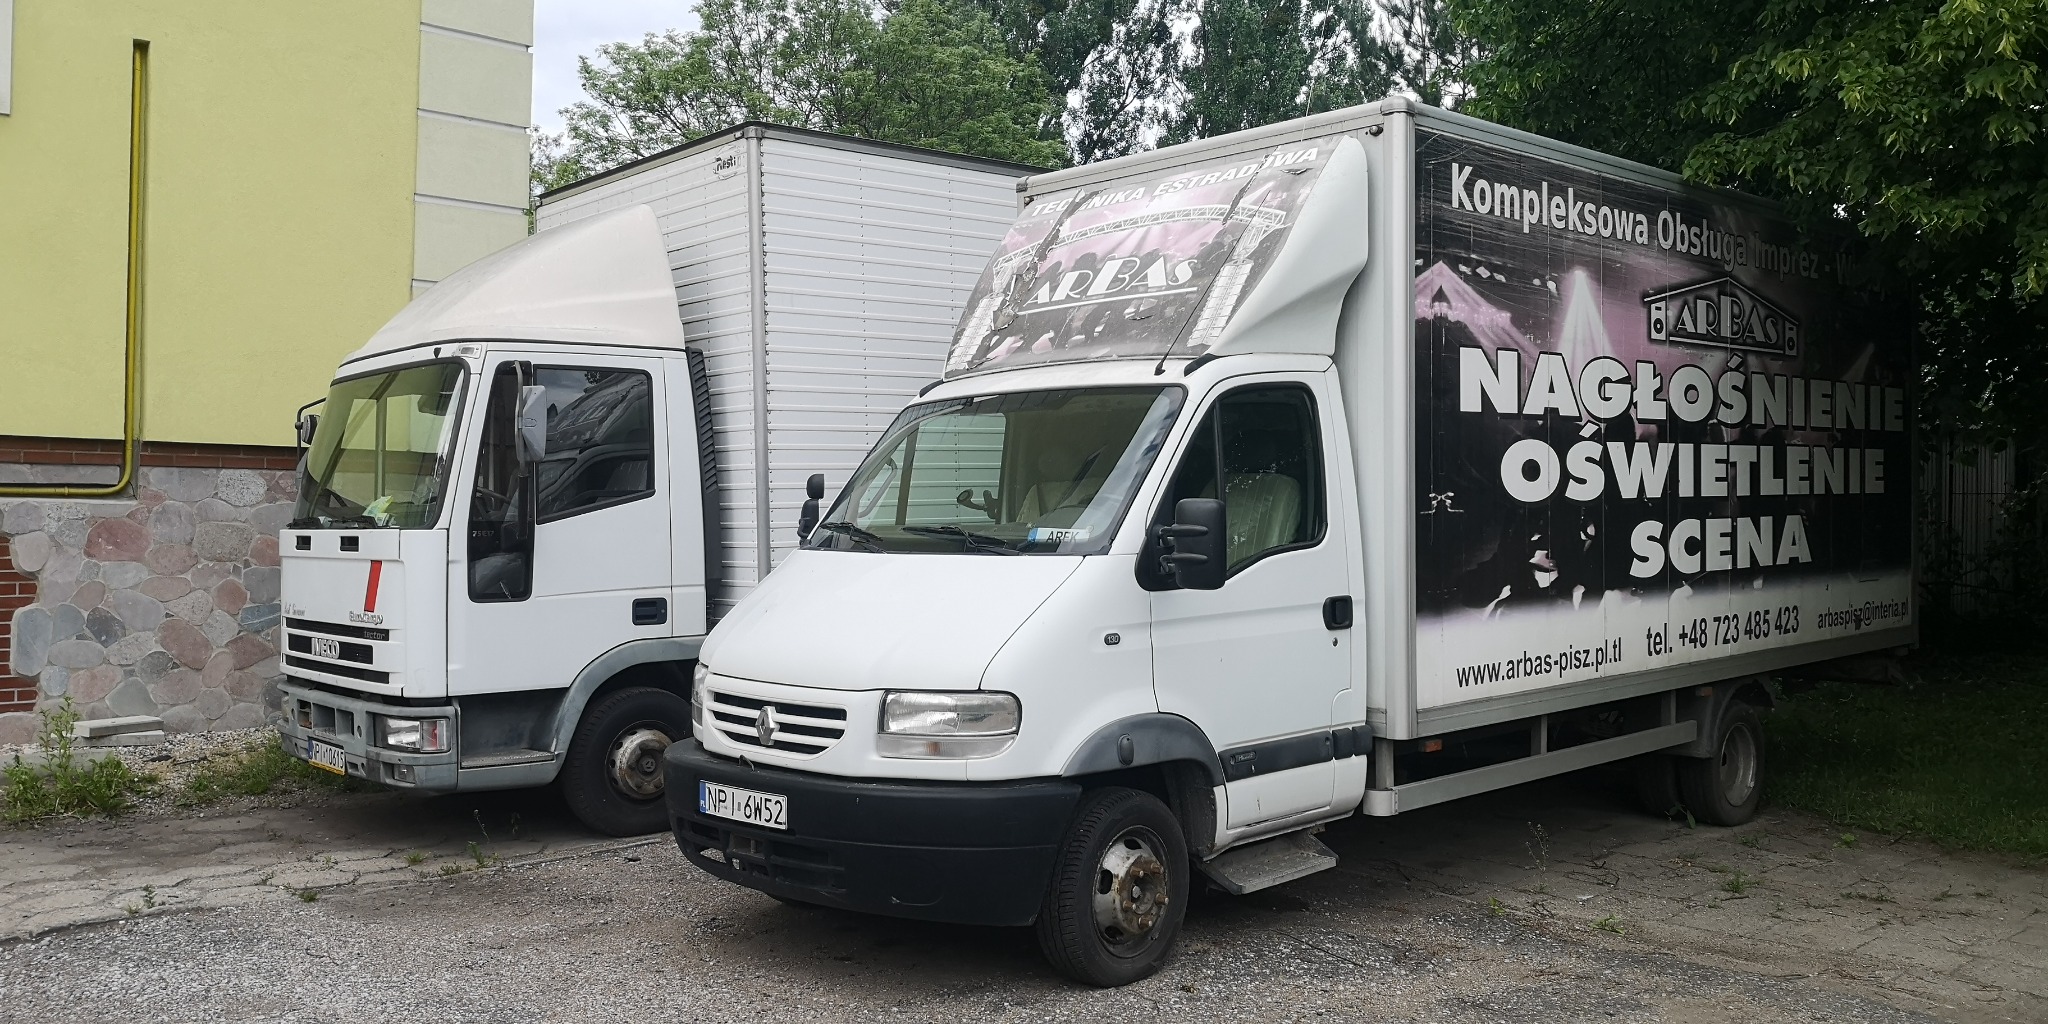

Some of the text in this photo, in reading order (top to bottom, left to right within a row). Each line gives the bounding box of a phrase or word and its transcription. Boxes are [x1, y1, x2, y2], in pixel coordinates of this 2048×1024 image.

[1032, 187, 1146, 217] TECNIKA
[1451, 162, 1650, 245] Kompleksowa
[1657, 210, 1748, 273] Obsługa
[1023, 255, 1198, 307] ARBAS
[1676, 294, 1778, 344] ARBAS
[1459, 346, 1905, 433] NAGŁOŚNIENIE
[1500, 420, 1886, 503] OŚWIETLENIE
[1629, 514, 1813, 579] SCENA
[311, 637, 340, 660] IVECO
[1106, 635, 1119, 644] 130
[1646, 605, 1800, 657] tel. +48 723 485 423
[1456, 636, 1622, 688] www.arbas-pisz.pl.tl
[707, 787, 784, 826] NPI 6W52
